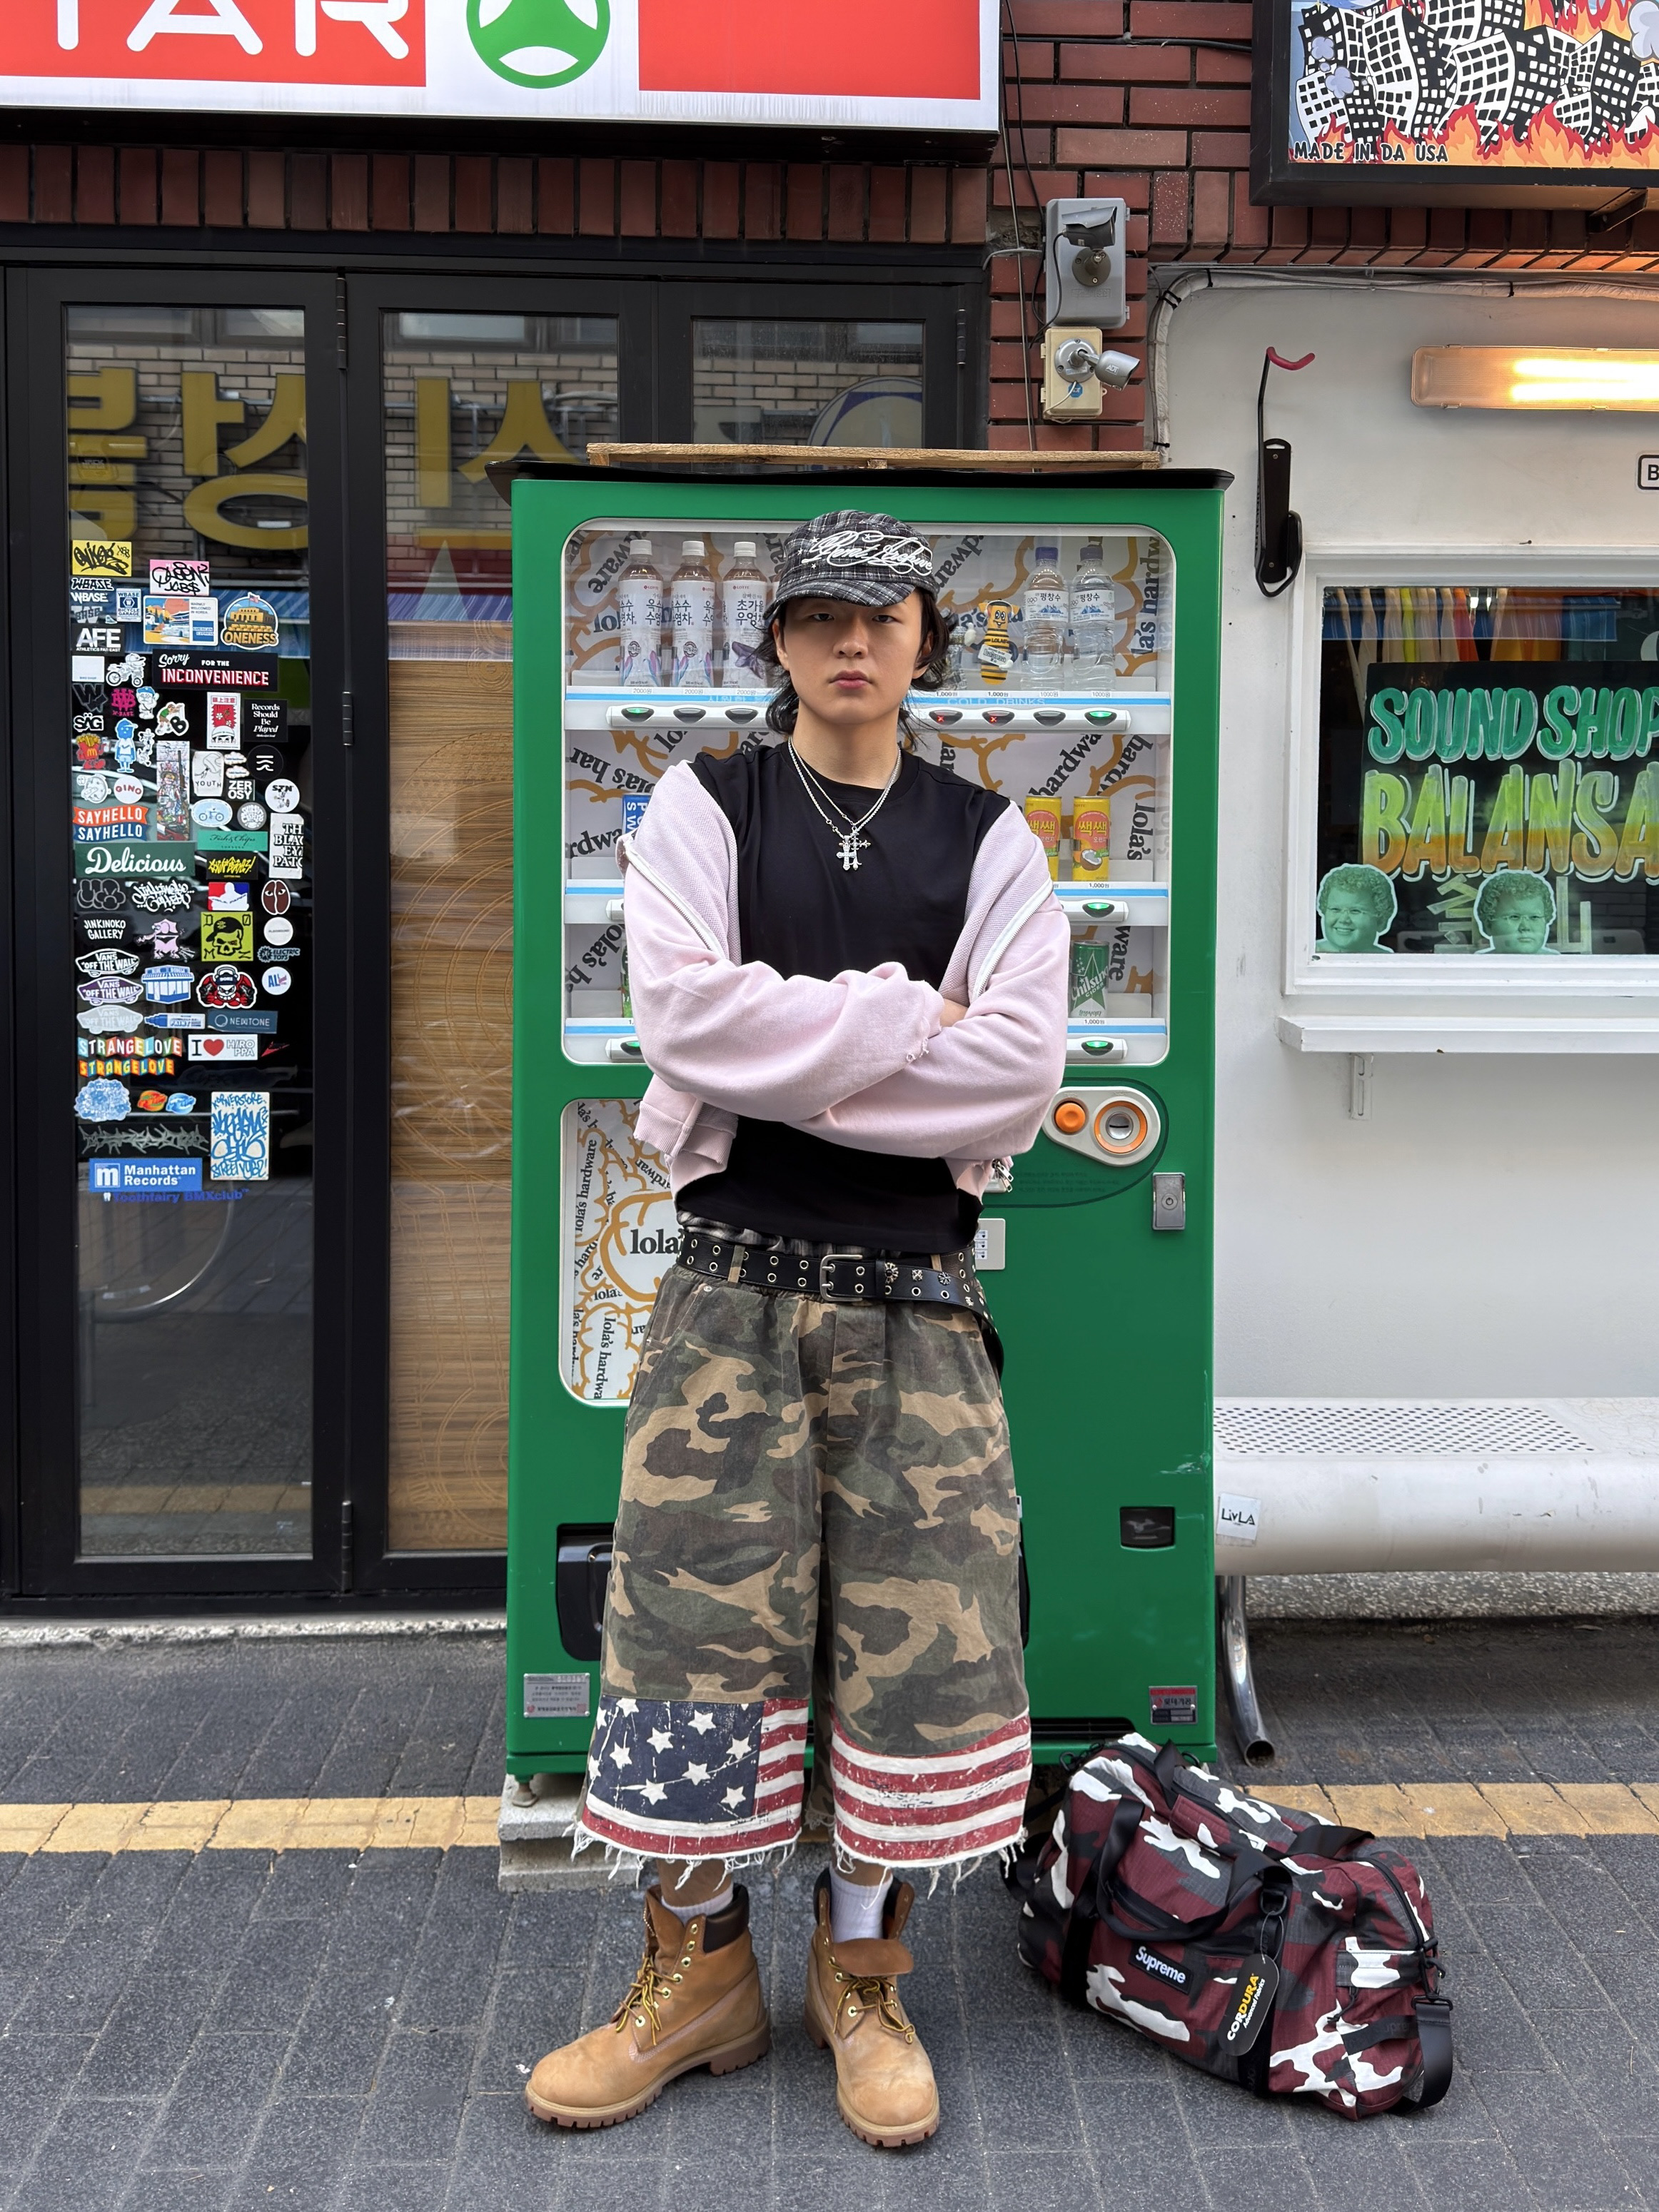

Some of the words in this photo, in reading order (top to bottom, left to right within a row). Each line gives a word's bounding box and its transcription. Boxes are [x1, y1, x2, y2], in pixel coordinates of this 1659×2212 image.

[1294, 141, 1345, 163] MADE
[1354, 143, 1375, 163] IN
[1381, 143, 1406, 163] DA
[1415, 144, 1450, 163] USA
[1106, 364, 1119, 374] ADT
[72, 578, 114, 591] WBASE
[71, 592, 109, 604] WBASE
[1040, 592, 1061, 602] 평창수
[1080, 593, 1100, 602] 평창수
[76, 627, 121, 647] AFE
[224, 632, 277, 645] ONENESS
[158, 653, 190, 668] Sorry
[161, 668, 270, 686] INCONVENIENCE
[253, 725, 279, 734] Played
[1367, 687, 1538, 763] SOUND
[116, 784, 142, 795] GINO
[78, 807, 143, 824] SAYHELLO
[78, 824, 143, 841] SAYHELLO
[85, 847, 186, 874] Delicious
[84, 919, 126, 930] JINKINOKO
[87, 929, 123, 940] GALLERY
[96, 952, 118, 961] VANS
[99, 961, 115, 971] THE
[97, 979, 120, 989] VANS
[1085, 981, 1104, 997] CIDER
[101, 989, 117, 999] THE
[97, 1008, 120, 1016] VANS
[79, 1039, 181, 1056] STRANGELOVE
[191, 1039, 202, 1056] I
[80, 1059, 174, 1076] STRANGELOVE
[124, 1165, 196, 1176] Manhattan
[577, 1139, 597, 1200] hardware
[124, 1175, 179, 1186] Records
[575, 1200, 588, 1232] lola's
[601, 1317, 617, 1348] lola's
[1135, 1944, 1187, 1984] Supreme
[1226, 1976, 1259, 2041] CORDURA
[1244, 1998, 1258, 2029] Advanced
[1254, 1978, 1266, 2001] Fabrics
